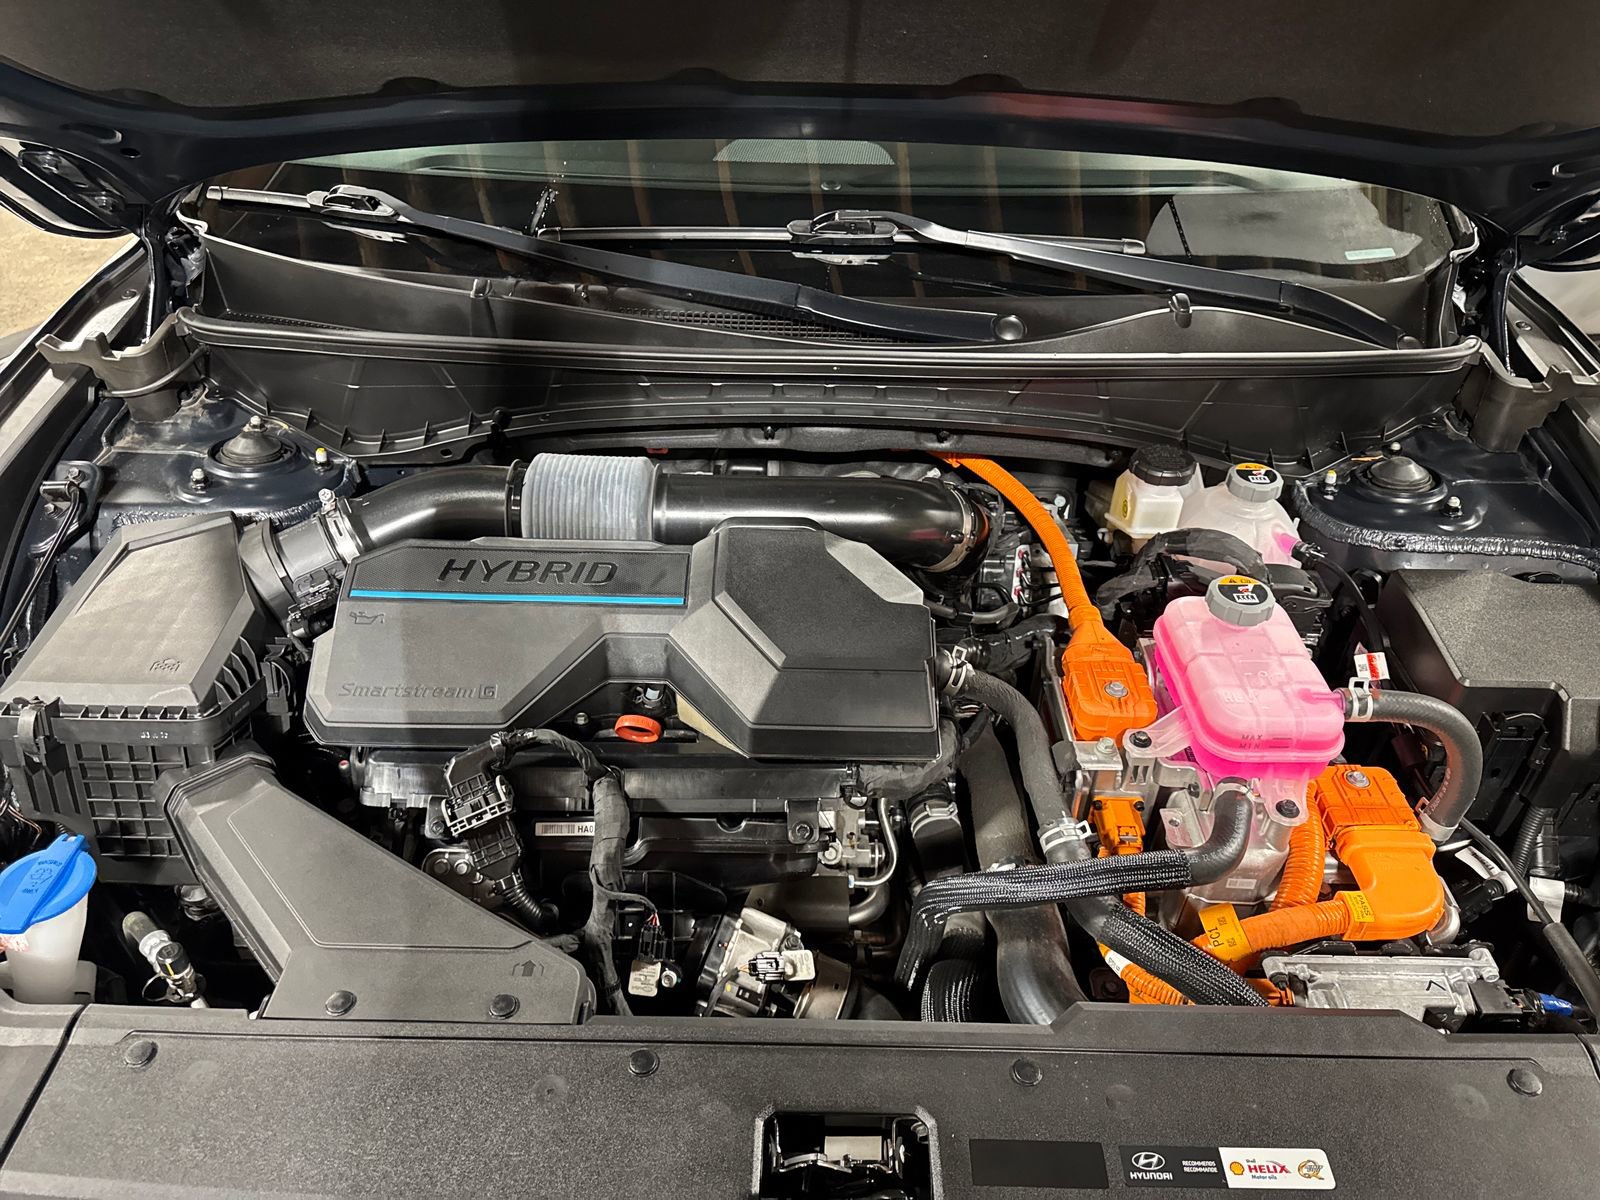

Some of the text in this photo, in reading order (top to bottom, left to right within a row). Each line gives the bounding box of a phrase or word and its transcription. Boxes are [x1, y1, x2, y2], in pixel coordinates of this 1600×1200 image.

[436, 559, 619, 586] HYBRID
[338, 683, 476, 698] Smartstream
[1247, 1164, 1289, 1174] HELIX
[1130, 1171, 1173, 1180] HYUNDAI
